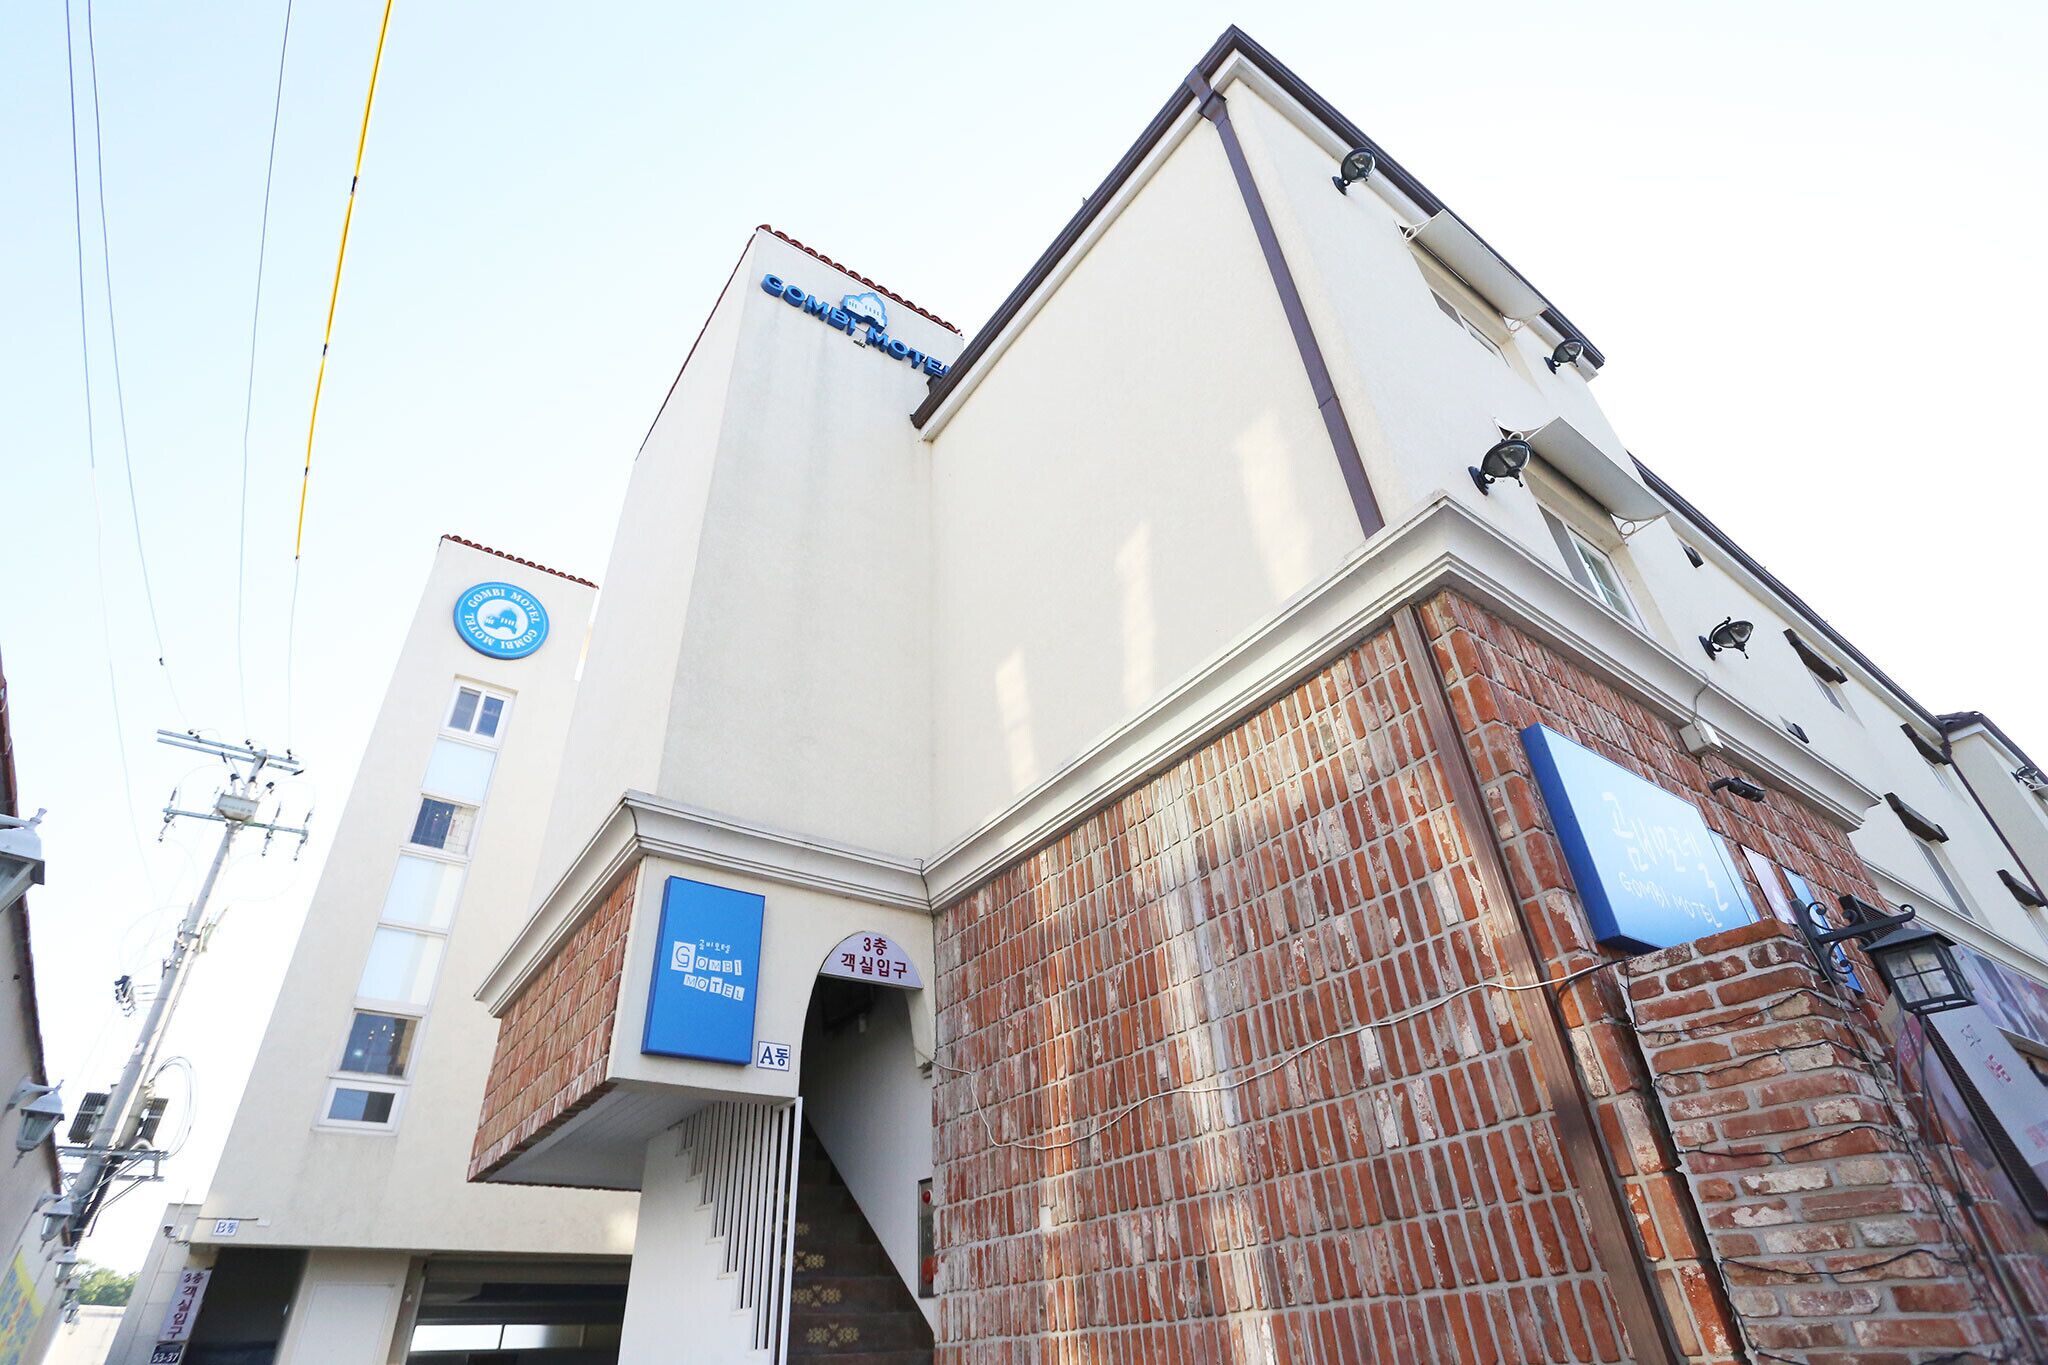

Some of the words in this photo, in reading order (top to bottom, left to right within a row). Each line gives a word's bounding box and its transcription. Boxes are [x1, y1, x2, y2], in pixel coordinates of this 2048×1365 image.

[761, 273, 856, 336] GOMBI
[467, 588, 505, 608] GOMBI
[511, 592, 541, 623] MOTEL
[465, 613, 495, 646] MOTEL
[500, 630, 538, 650] GOMBI
[1618, 872, 1670, 908] GOMBI
[1672, 894, 1723, 928] MOTEL
[863, 936, 888, 956] 3층
[840, 952, 908, 980] 객실입구
[684, 974, 745, 1001] MOTEL
[759, 1045, 788, 1068] A동
[215, 1221, 238, 1234] B동
[183, 1271, 204, 1283] 3층
[167, 1285, 198, 1339] 객실입구
